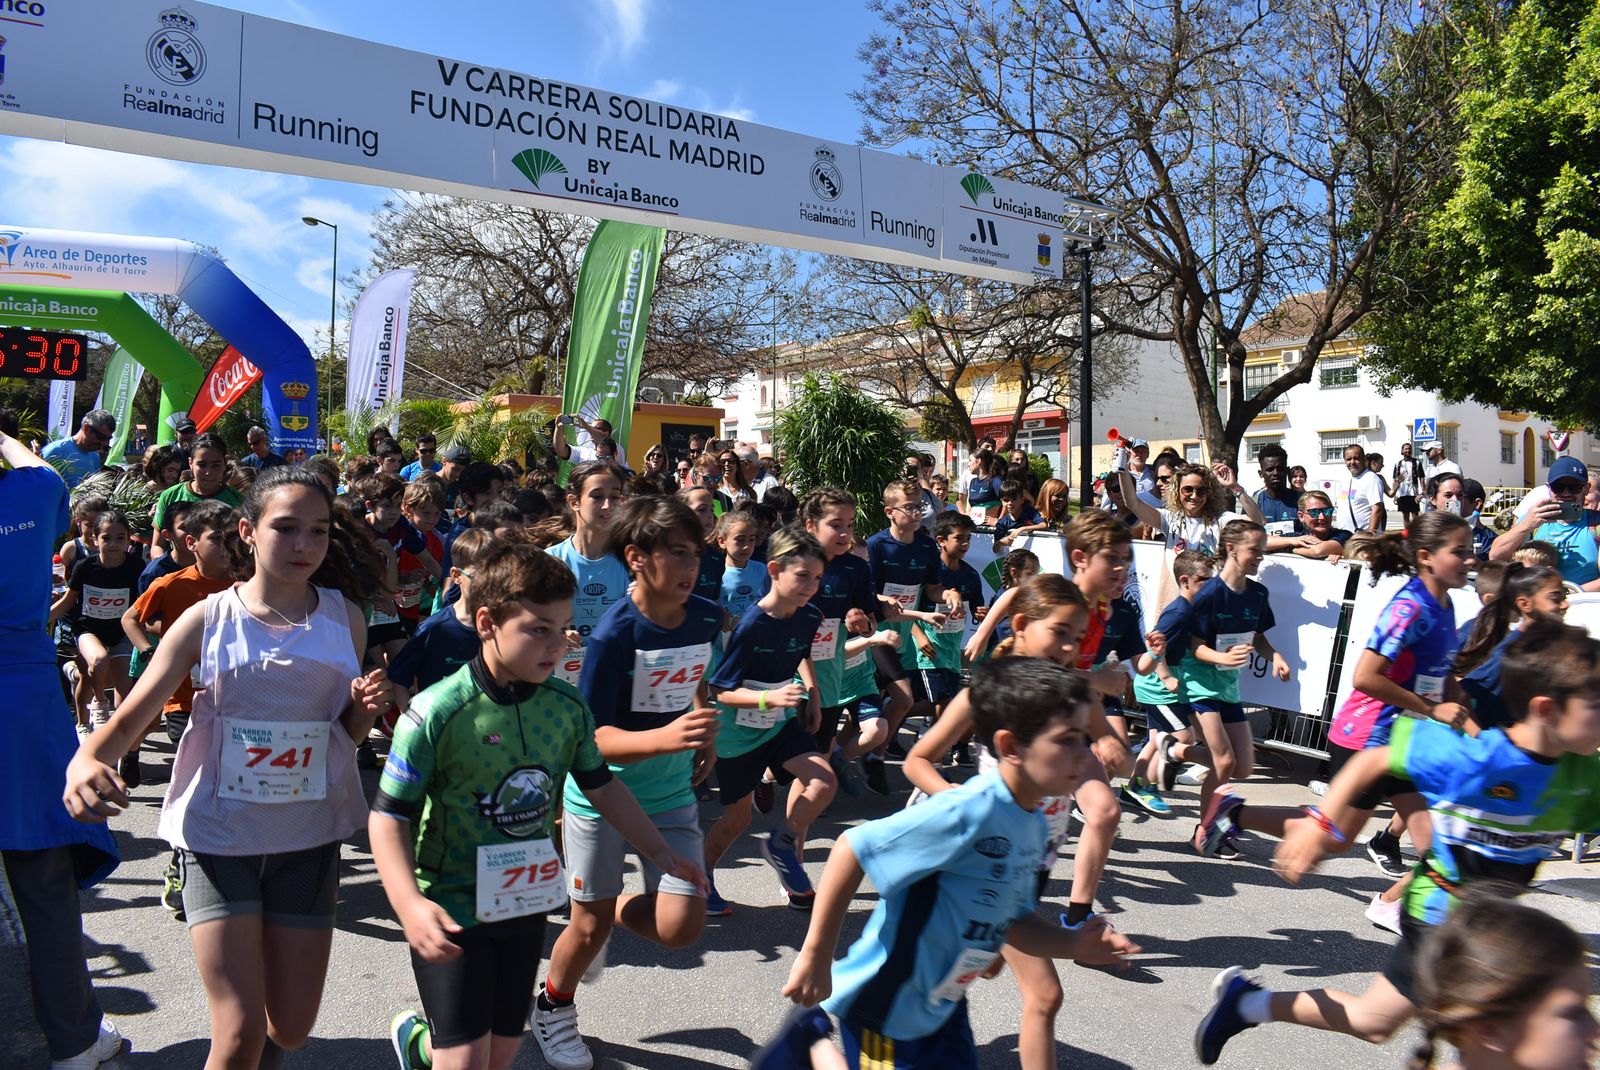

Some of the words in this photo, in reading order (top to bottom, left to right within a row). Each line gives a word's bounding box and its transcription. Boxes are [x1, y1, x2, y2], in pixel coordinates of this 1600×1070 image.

[123, 83, 226, 109] FUNDACIÓN
[123, 93, 226, 125] Realmadrid
[437, 58, 460, 87] V
[465, 66, 601, 115] CARRERA
[607, 96, 741, 143] SOLIDARIA
[253, 101, 380, 158] Running
[409, 90, 588, 146] FUNDACIÓN
[596, 126, 662, 159] REAL
[668, 138, 766, 176] MADRID
[587, 158, 611, 176] BY
[563, 176, 629, 204] Unicaja
[631, 187, 680, 209] Banco
[799, 201, 857, 217] FUNDACIÓN
[799, 208, 857, 229] Realmadrid
[993, 196, 1034, 219] Unicaja
[1034, 205, 1065, 224] Banco
[870, 210, 936, 249] Running
[23, 245, 58, 260] Area
[62, 248, 81, 261] de
[84, 249, 149, 267] Deportes
[958, 243, 986, 255] Diputación
[986, 248, 1010, 260] Provincial
[971, 255, 979, 263] de
[23, 260, 49, 270] Ayto.
[96, 265, 108, 273] de
[111, 266, 121, 274] la
[124, 267, 148, 276] Torre
[616, 248, 643, 316] Banco
[49, 300, 99, 317] Banco
[378, 306, 395, 351] Banco
[605, 318, 634, 399] Unicaja
[119, 363, 132, 389] Banco
[373, 353, 393, 410] Unicaja
[60, 399, 71, 428] Unicaja
[88, 596, 126, 607] 670
[231, 733, 273, 744] SOLDARIA
[237, 727, 273, 737] CARRERA
[244, 746, 313, 769] 741
[501, 857, 561, 890] 719
